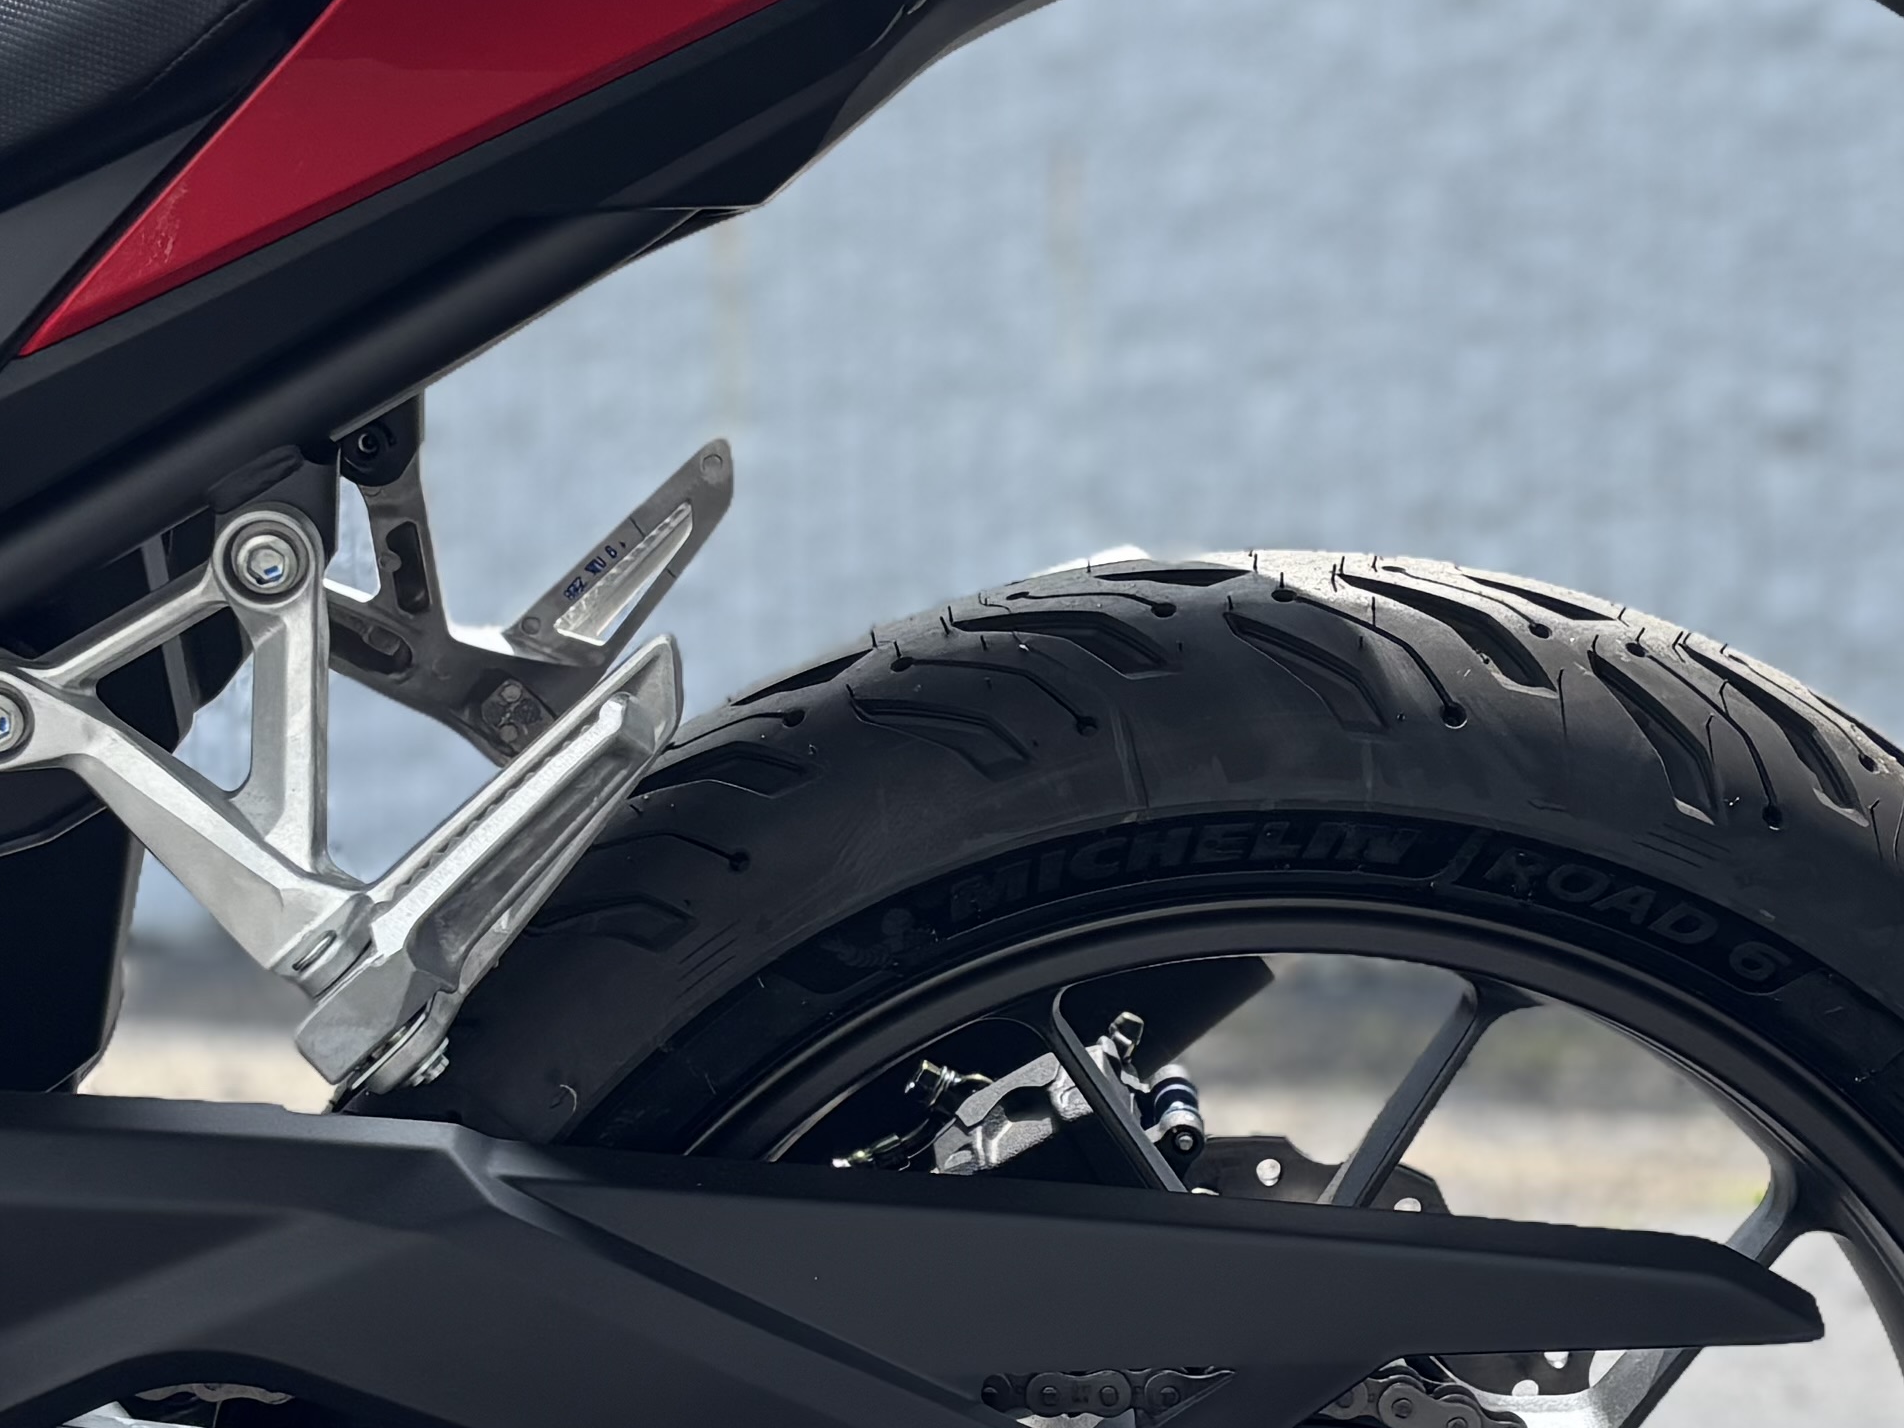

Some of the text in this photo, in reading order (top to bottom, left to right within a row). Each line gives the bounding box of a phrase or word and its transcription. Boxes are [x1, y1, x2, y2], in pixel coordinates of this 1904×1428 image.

[950, 821, 1793, 982] MICHELIN ROAD 6
